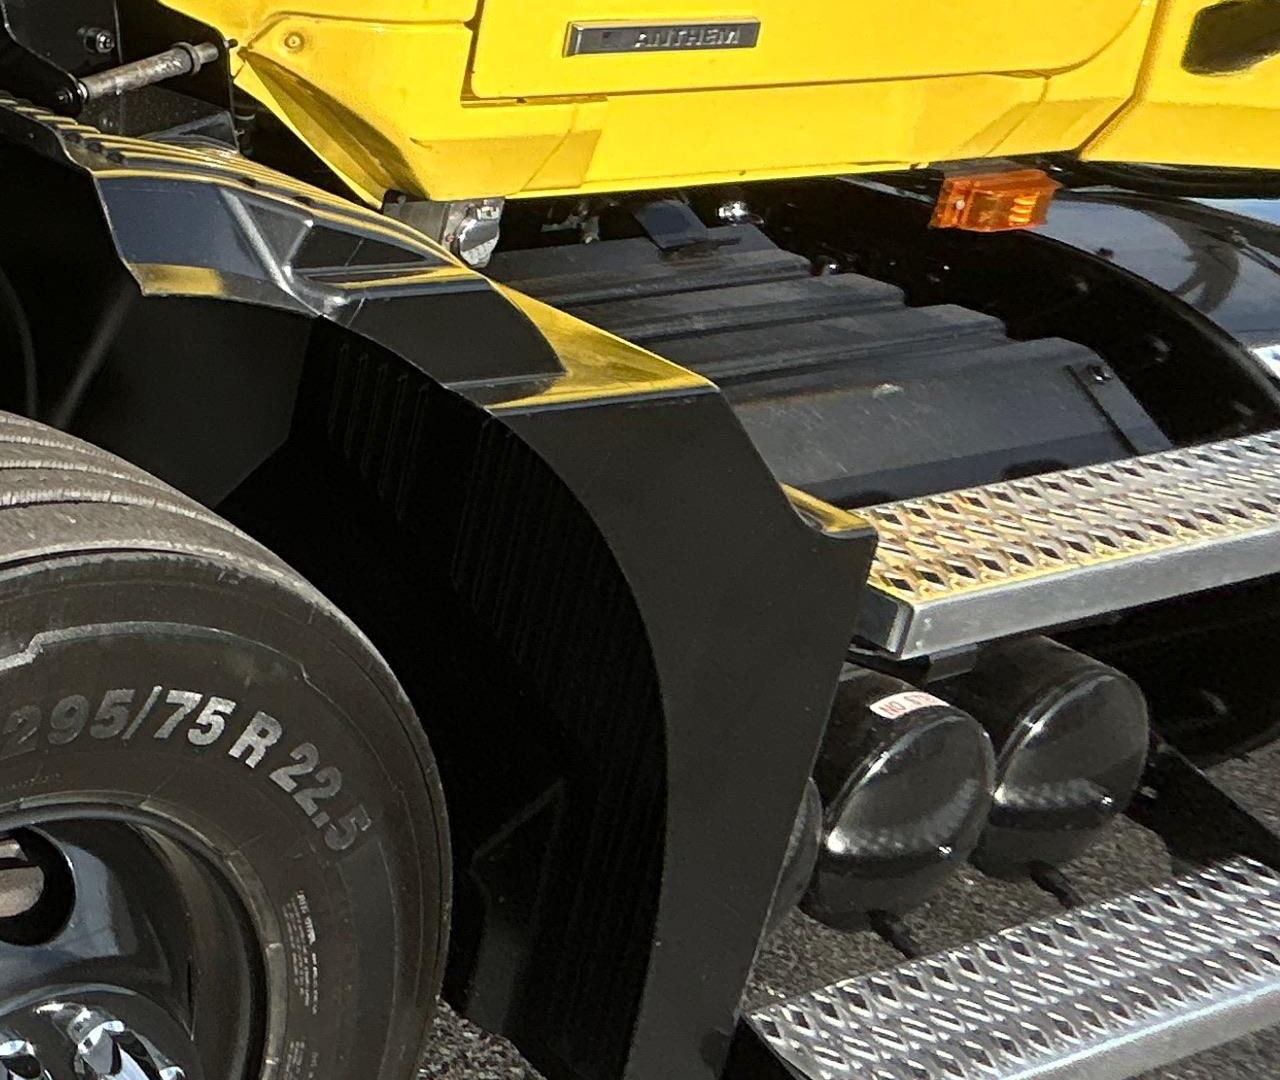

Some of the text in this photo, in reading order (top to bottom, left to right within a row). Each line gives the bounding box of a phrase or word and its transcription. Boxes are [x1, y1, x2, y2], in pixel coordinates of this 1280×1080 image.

[632, 28, 740, 48] ANTHEM
[228, 710, 283, 769] R
[268, 741, 372, 852] 22.5
